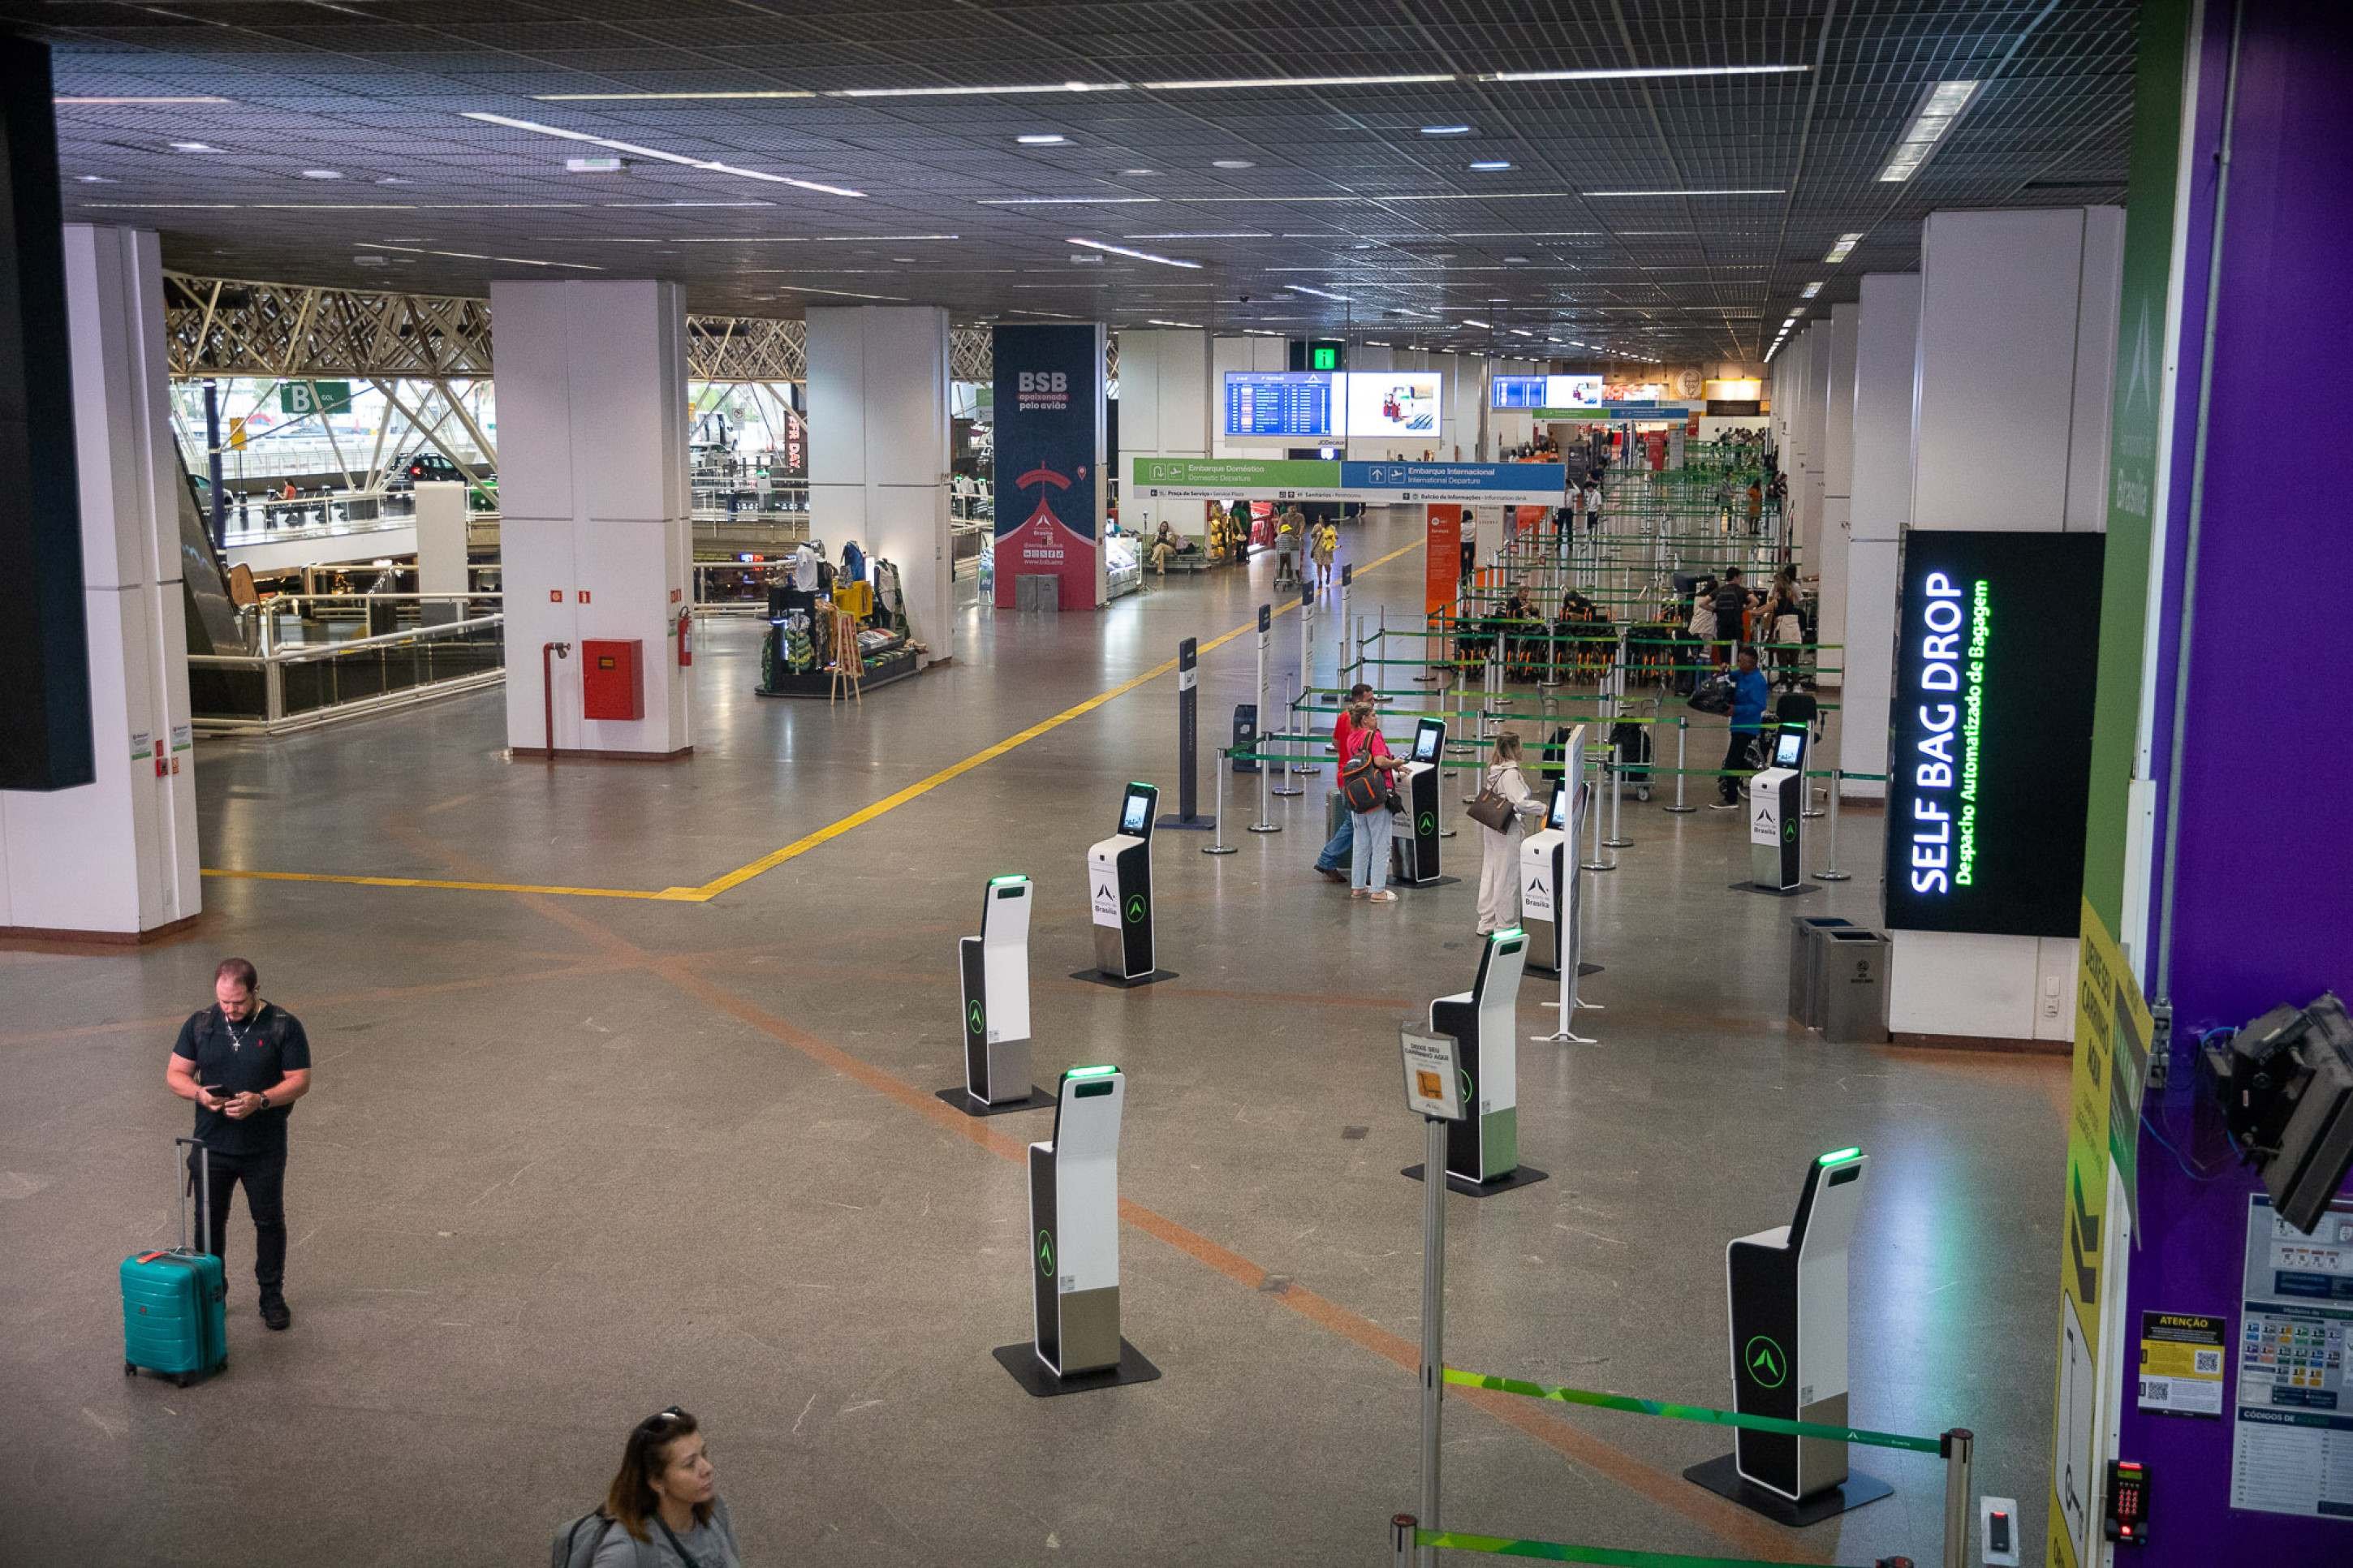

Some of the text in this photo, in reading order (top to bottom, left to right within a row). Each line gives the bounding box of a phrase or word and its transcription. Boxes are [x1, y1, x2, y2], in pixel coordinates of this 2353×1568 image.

[1019, 373, 1067, 392] BSB
[292, 385, 310, 411] B
[1019, 393, 1067, 402] apaixonado
[1019, 401, 1067, 411] pelo avião
[1188, 464, 1265, 473] Embarque Doméstico
[1911, 572, 1963, 894] SELF BAG DROP
[1955, 579, 1991, 886] Despacho Automatizado de Bagagem
[2160, 1316, 2209, 1329] ATENÇÃO
[2243, 1410, 2282, 1422] CÓDIGOS
[2284, 1415, 2295, 1423] DE
